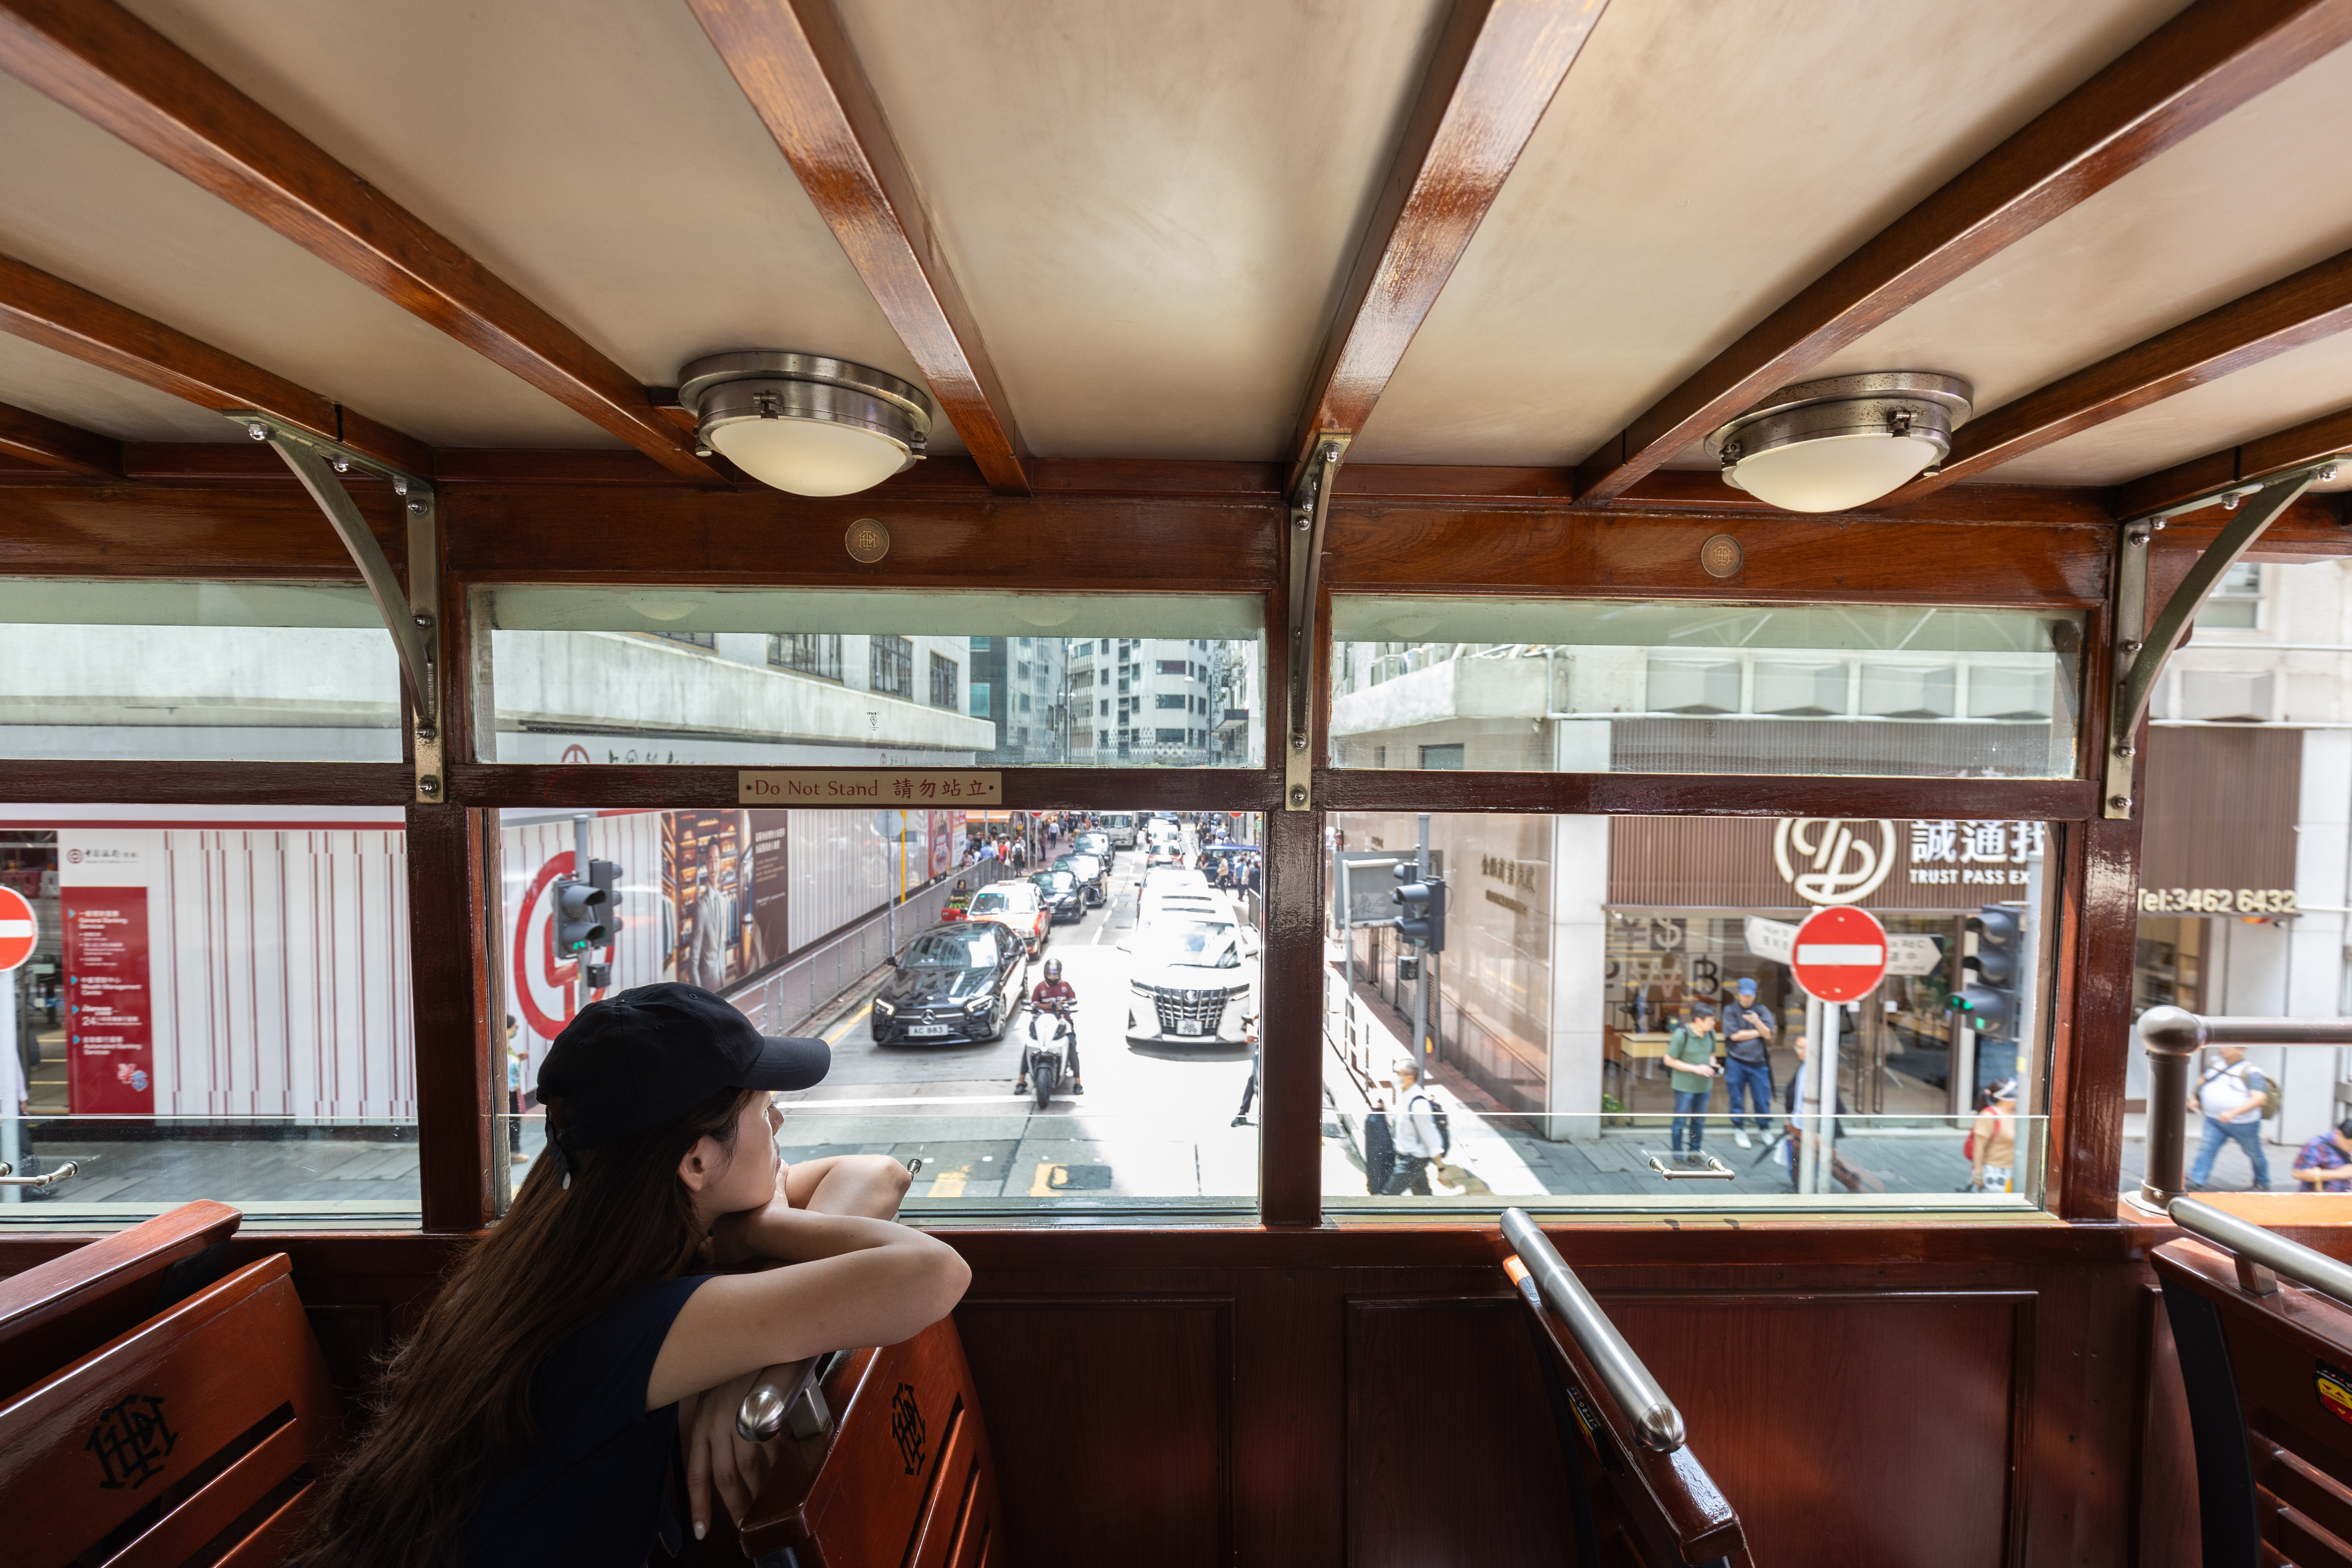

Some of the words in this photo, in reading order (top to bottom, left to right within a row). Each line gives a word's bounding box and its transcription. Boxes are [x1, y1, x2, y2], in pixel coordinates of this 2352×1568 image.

[754, 779, 780, 795] Do
[788, 780, 821, 796] Not
[828, 779, 878, 796] Stand
[892, 778, 987, 799] 請勿站立
[1909, 869, 1959, 885] TRUST
[1962, 869, 2006, 885] PASS
[2138, 888, 2233, 912] Tel:3462
[2236, 889, 2298, 913] 6432
[2323, 1389, 2349, 1405] CHANNEL
